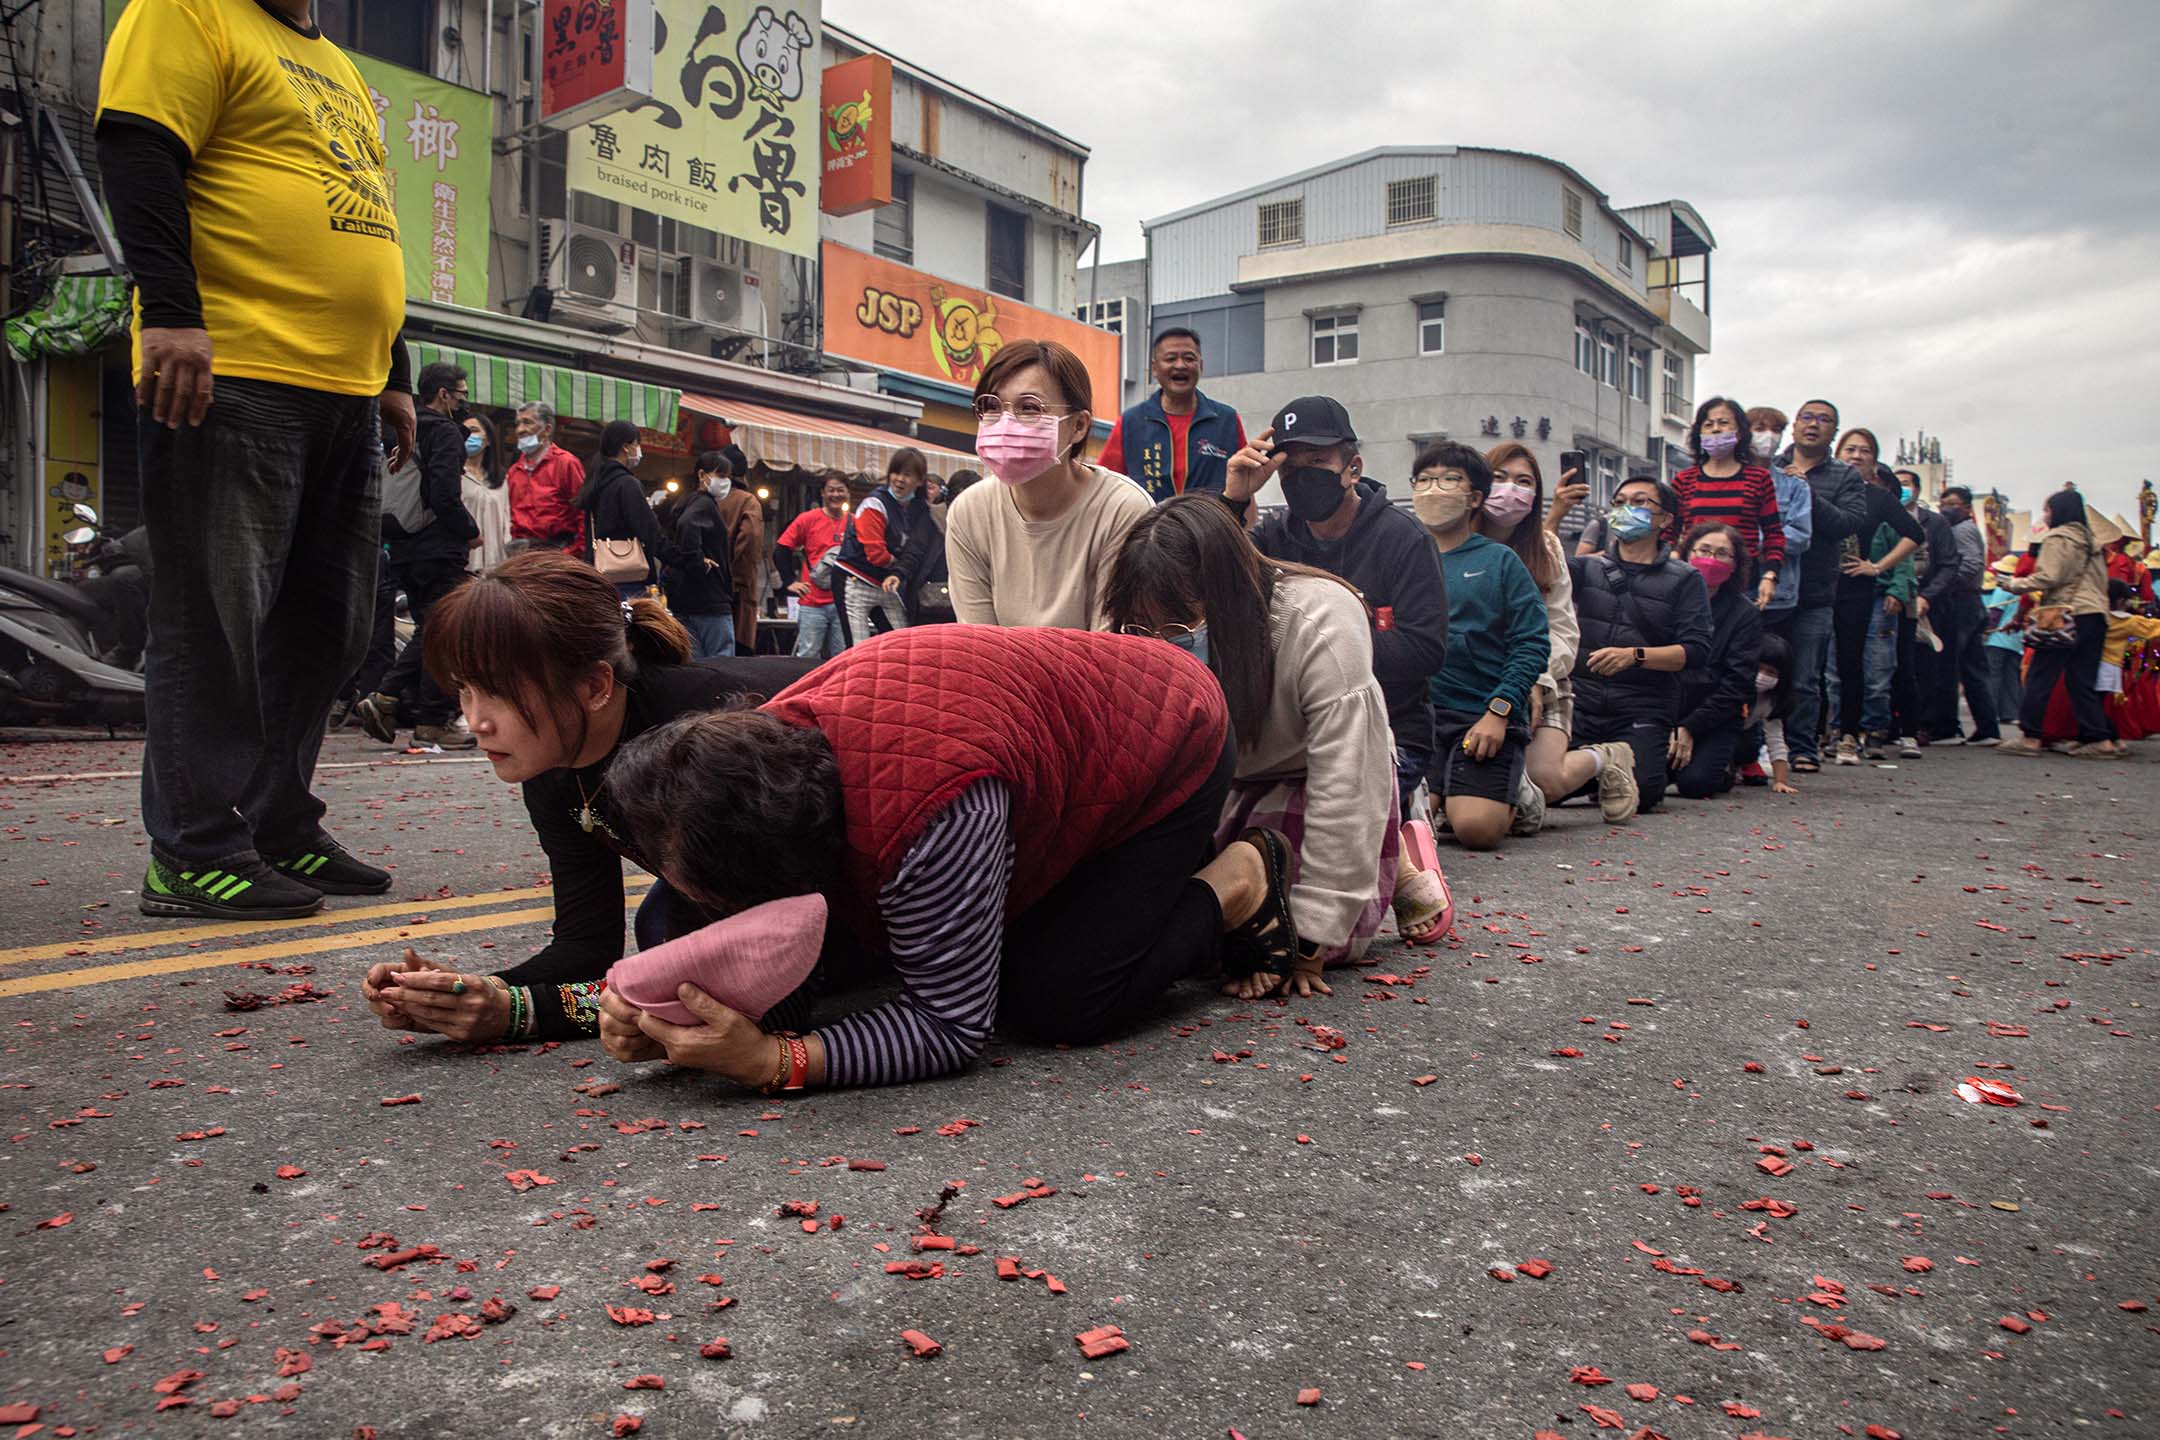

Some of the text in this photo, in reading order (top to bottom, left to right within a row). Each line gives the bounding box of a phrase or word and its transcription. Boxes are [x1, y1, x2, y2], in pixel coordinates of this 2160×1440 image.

[588, 122, 718, 193] 魯肉飯
[597, 166, 708, 213] braised pork rice
[333, 218, 392, 239] Taitung
[857, 287, 923, 338] JSP
[1284, 412, 1297, 431] P
